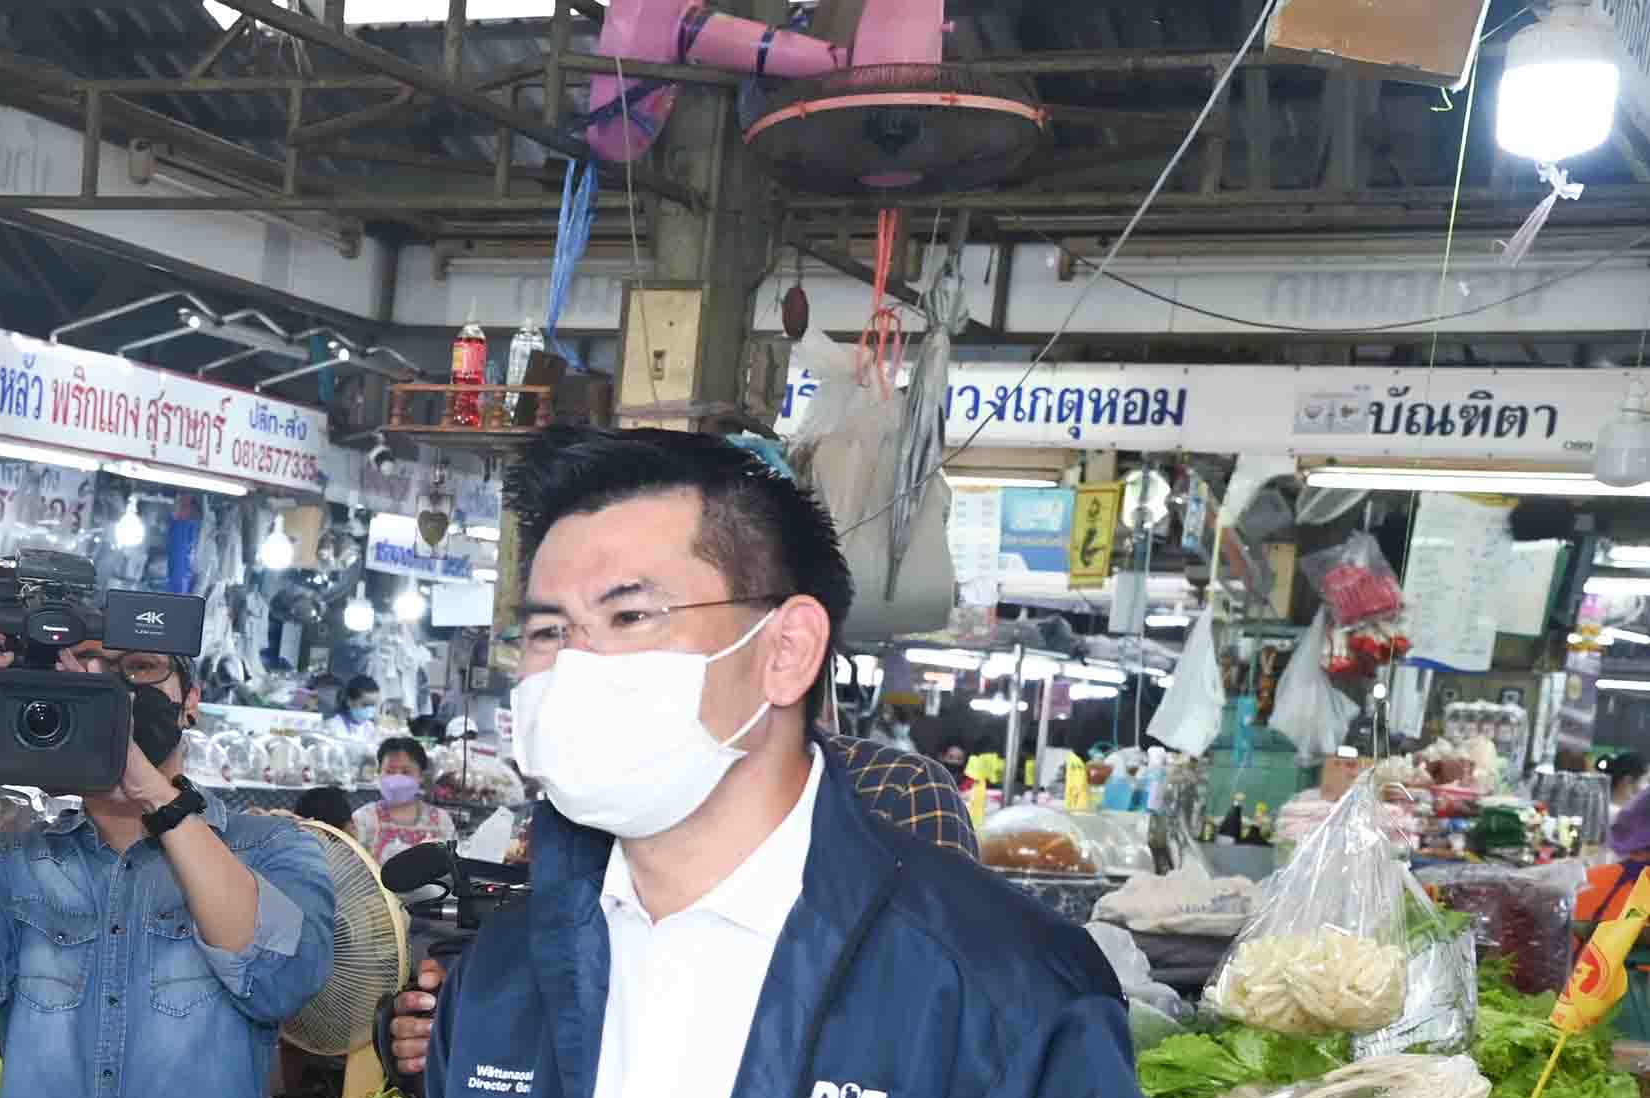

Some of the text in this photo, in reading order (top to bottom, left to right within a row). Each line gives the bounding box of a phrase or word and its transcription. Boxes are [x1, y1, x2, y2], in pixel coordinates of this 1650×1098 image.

[50, 365, 141, 440] พริกแกง
[1368, 385, 1559, 439] บัณฑิตา
[134, 611, 166, 625] 4K
[467, 1076, 512, 1093] Director
